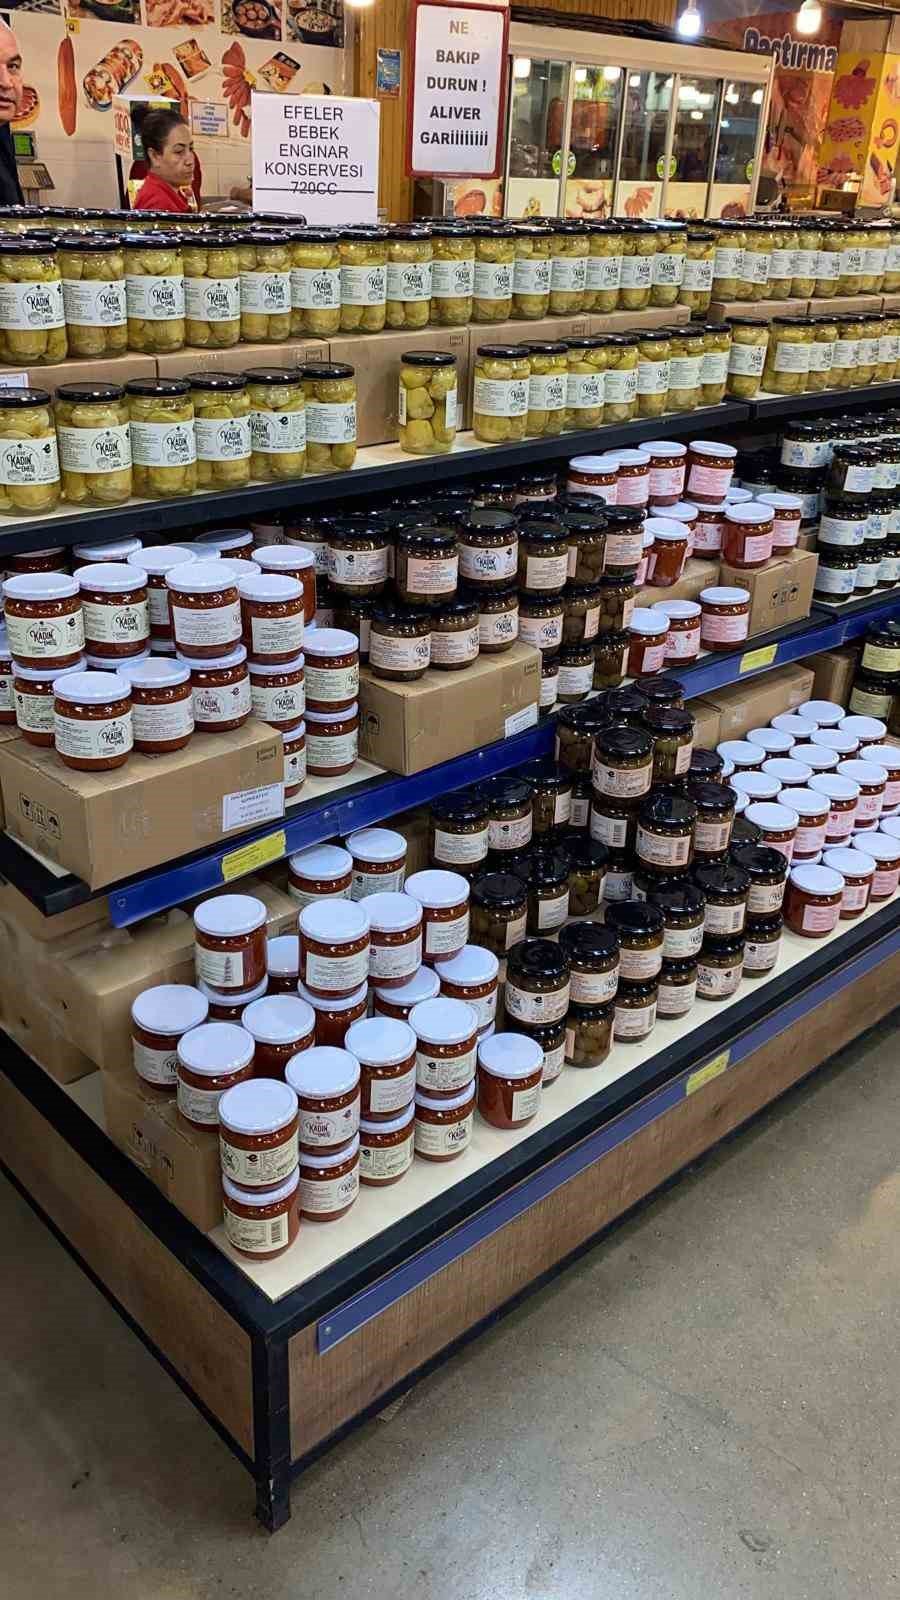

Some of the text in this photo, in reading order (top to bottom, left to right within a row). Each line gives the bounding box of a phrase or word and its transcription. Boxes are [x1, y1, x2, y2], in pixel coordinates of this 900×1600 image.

[449, 20, 469, 35] NE
[435, 49, 480, 65] BAKIP
[426, 76, 478, 92] DURUN
[283, 105, 344, 121] EFELER
[429, 105, 481, 121] ALIVER
[288, 125, 340, 140] BEBEK
[279, 144, 349, 159] ENGINAR
[264, 162, 364, 178] KONSERVESI
[26, 295, 50, 311] KADIN
[6, 453, 32, 469] KADIN
[29, 629, 54, 645] KADIN
